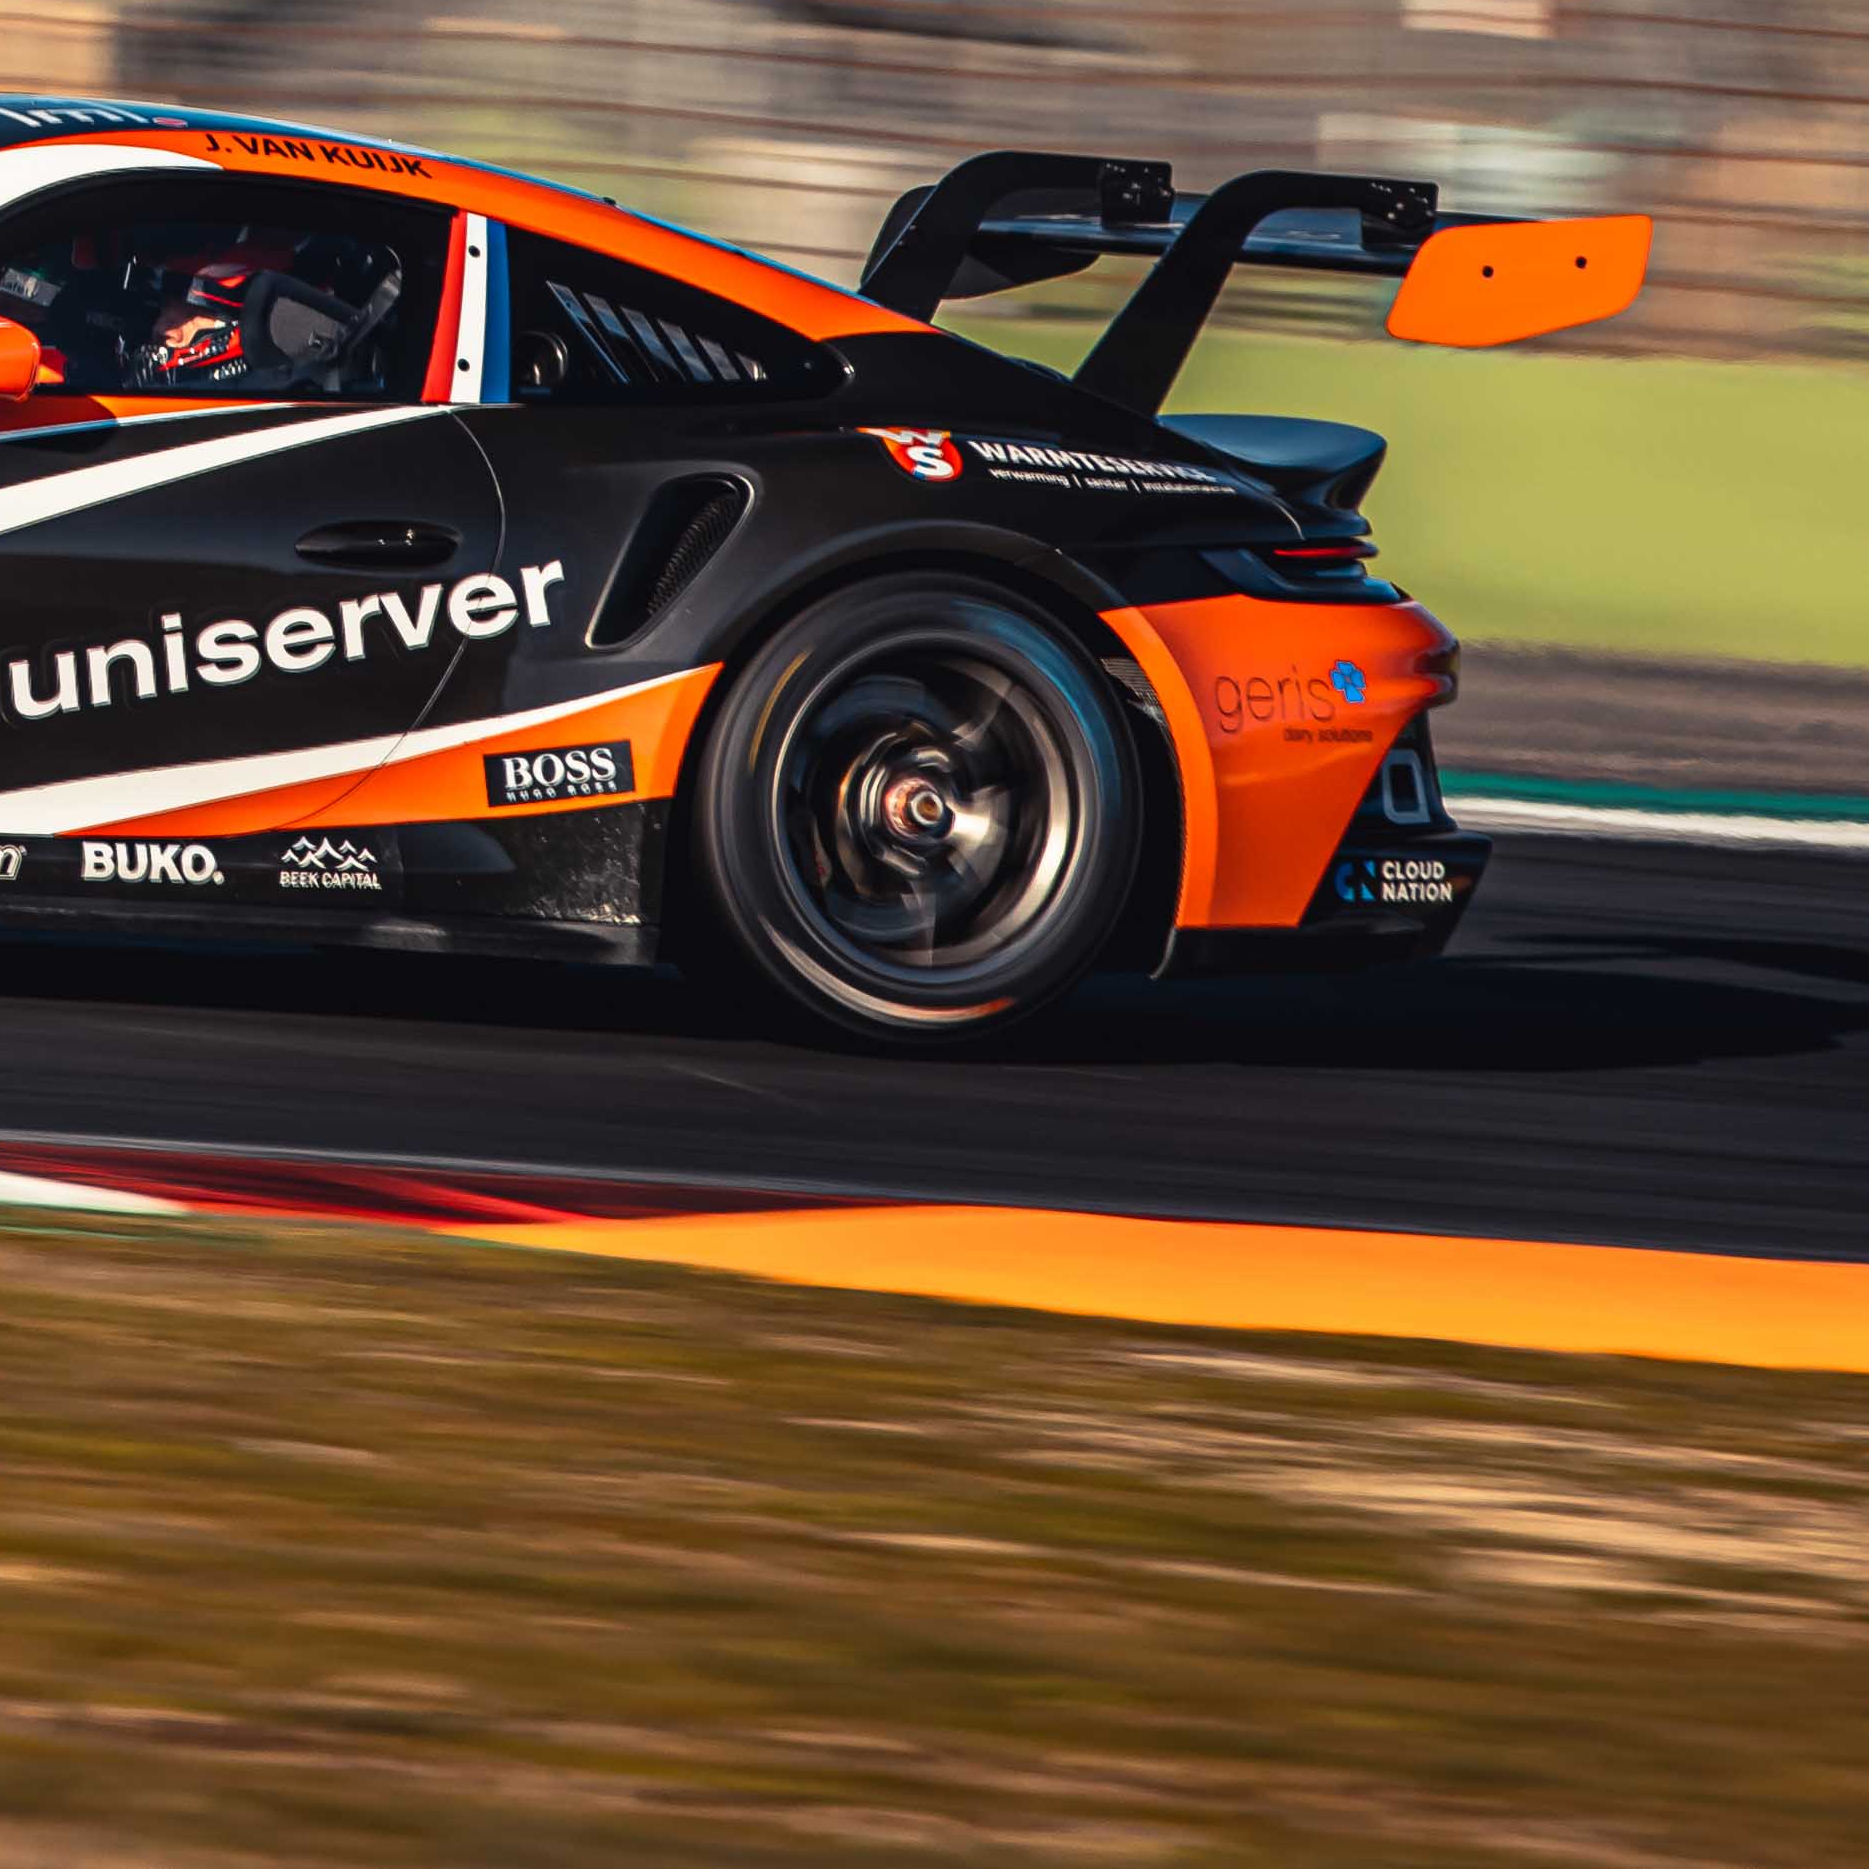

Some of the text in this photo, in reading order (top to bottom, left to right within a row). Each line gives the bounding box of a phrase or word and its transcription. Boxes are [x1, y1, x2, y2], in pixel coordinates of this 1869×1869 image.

[205, 134, 433, 179] J. VAN KUIJK
[9, 559, 565, 721] uniserver
[1215, 664, 1336, 735] geris
[502, 746, 617, 791] BOSS
[279, 871, 383, 890] BEEK CAPITAL
[1381, 860, 1446, 880] CLOUD
[1381, 882, 1454, 903] NATION
